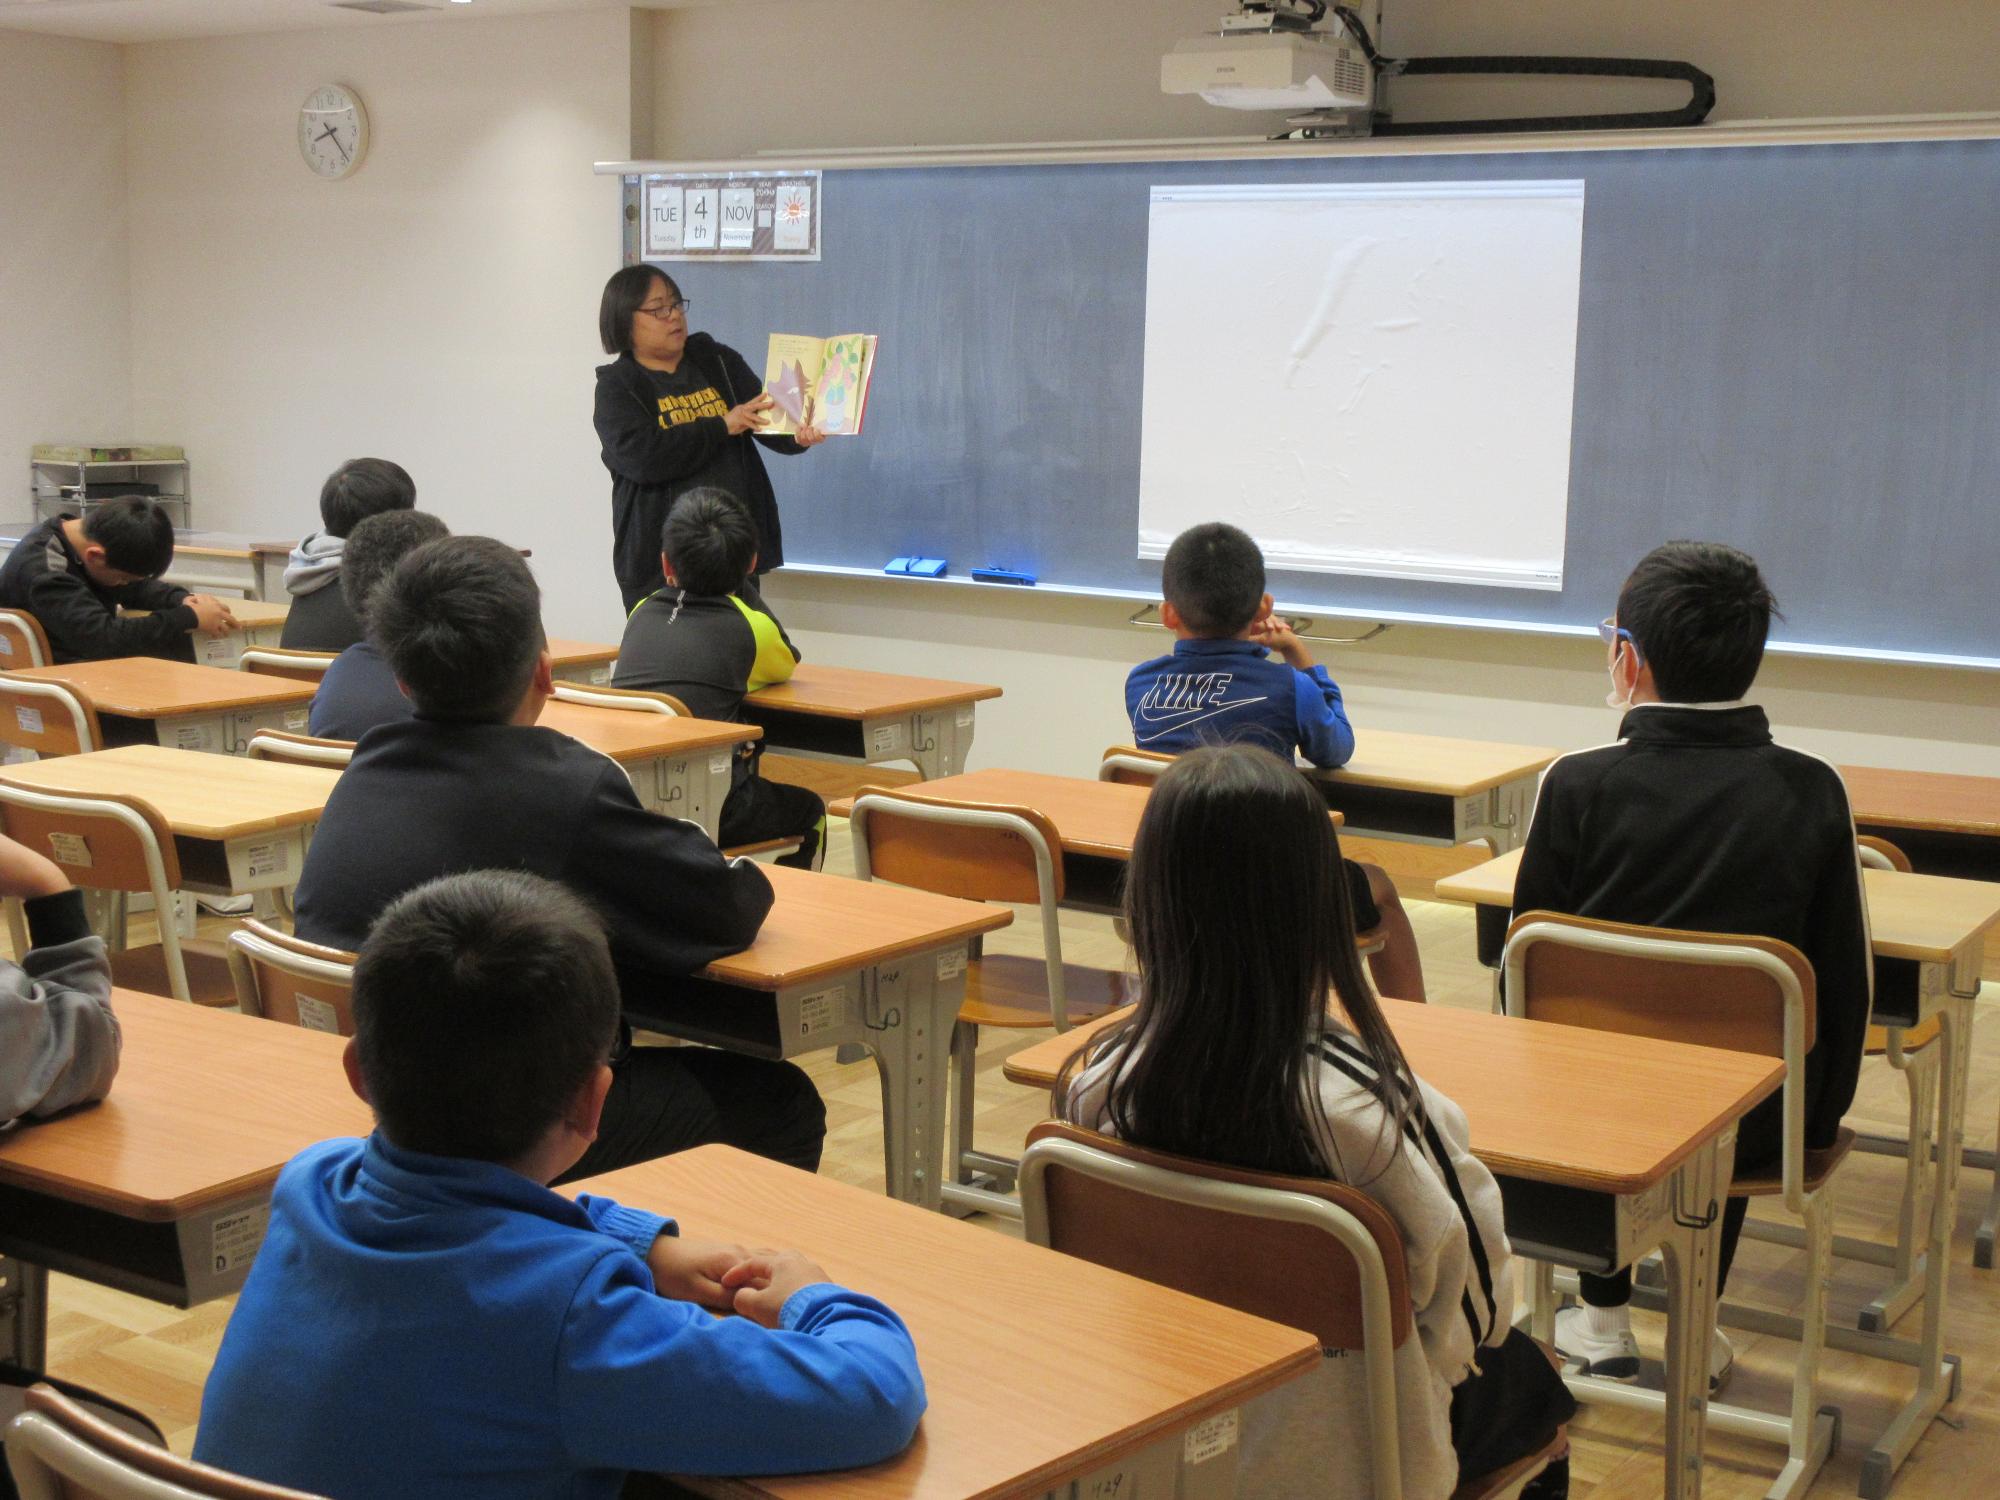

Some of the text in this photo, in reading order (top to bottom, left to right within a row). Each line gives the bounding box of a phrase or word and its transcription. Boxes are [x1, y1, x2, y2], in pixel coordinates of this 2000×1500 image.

[653, 207, 678, 222] TUE
[694, 196, 708, 220] 4
[725, 206, 753, 222] NOV
[694, 225, 707, 240] th
[723, 233, 753, 242] November
[1143, 672, 1233, 710] NIKE
